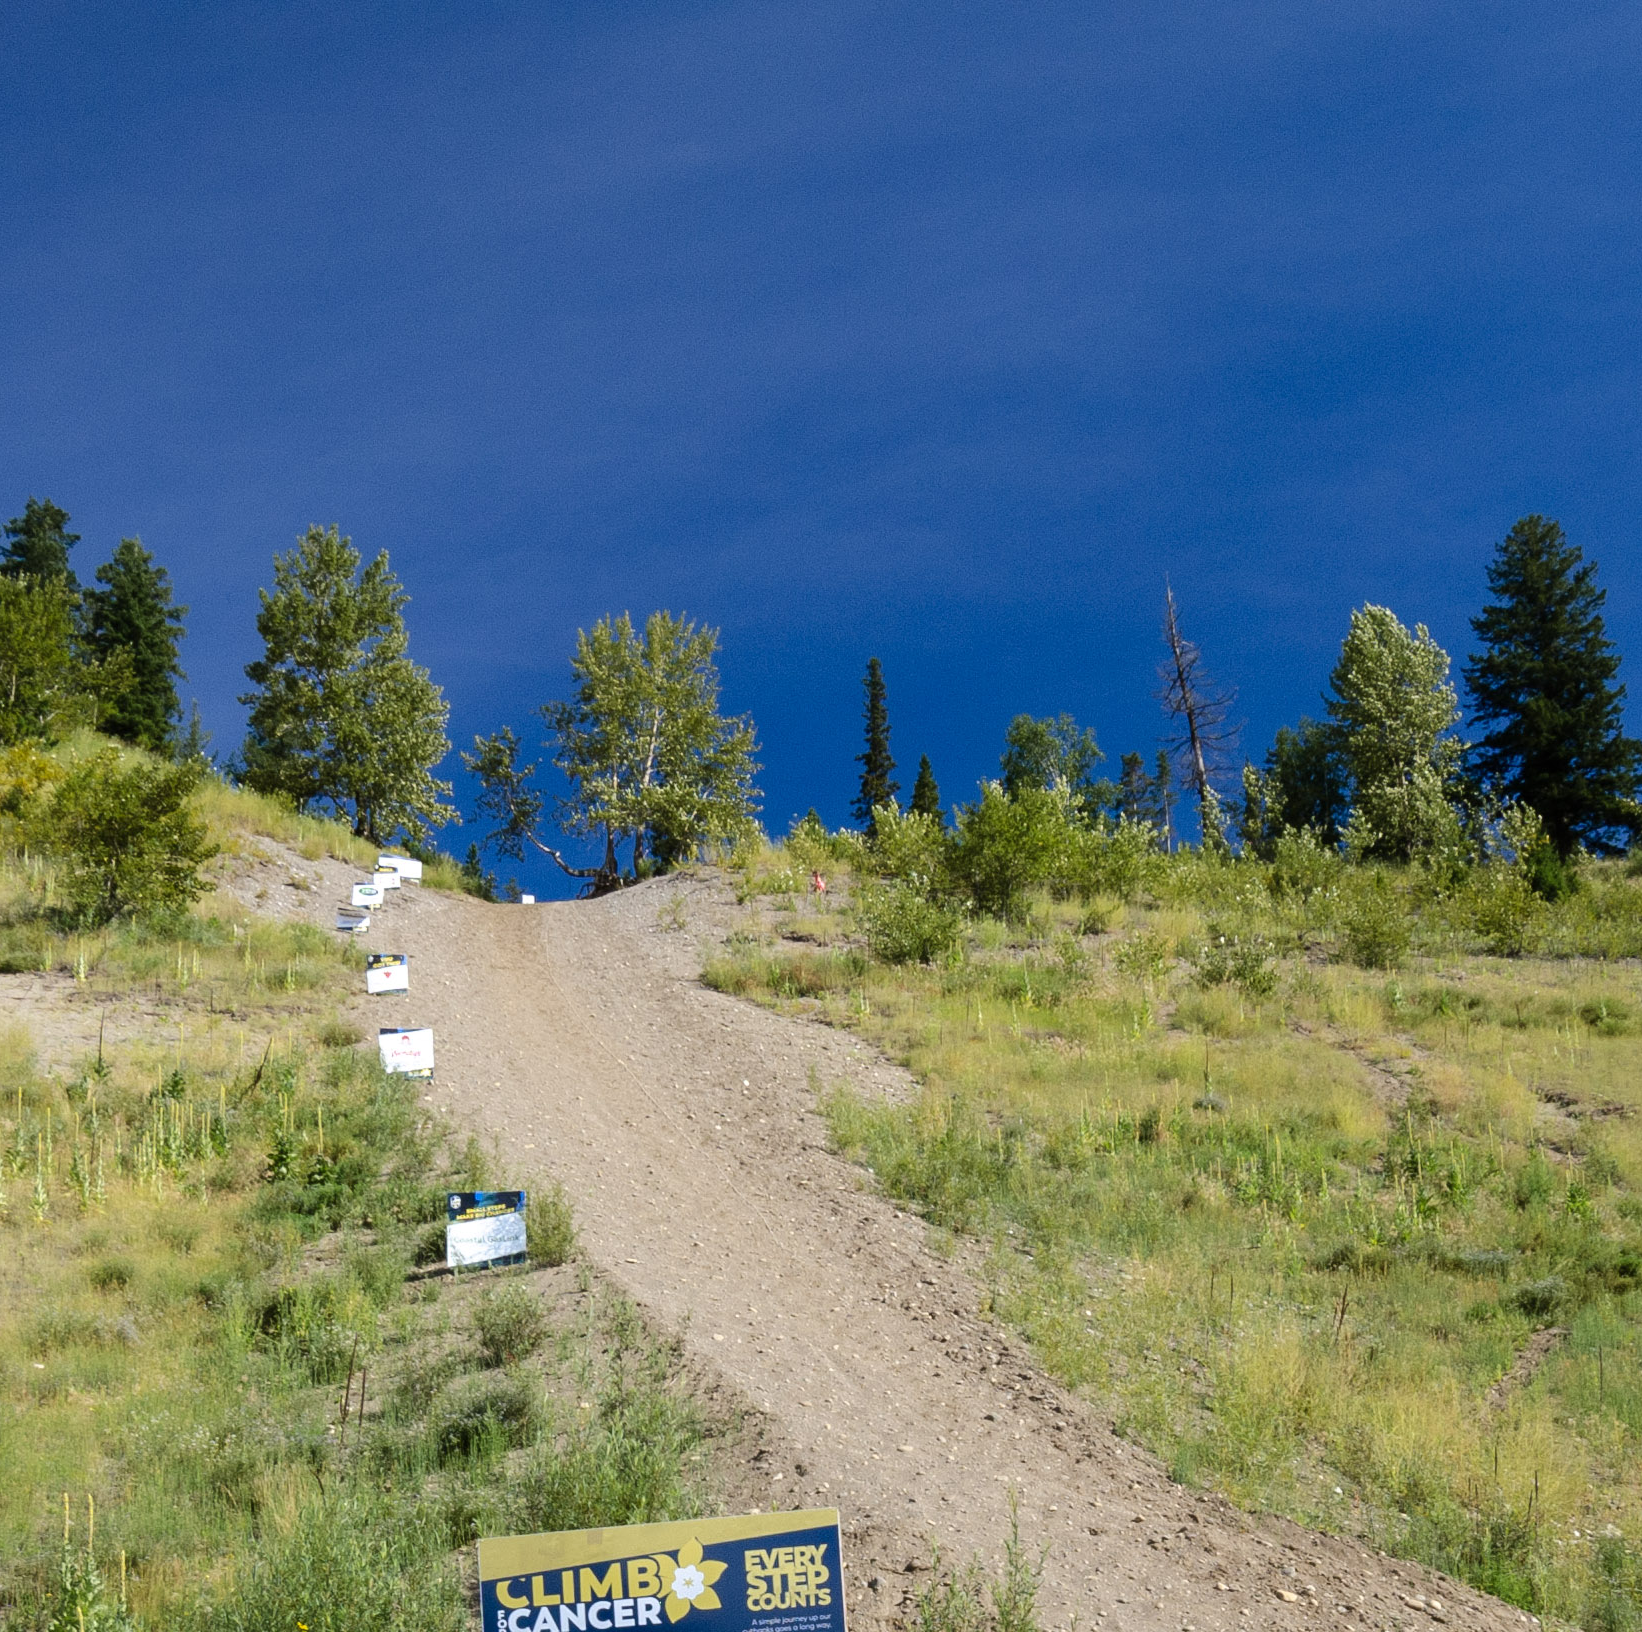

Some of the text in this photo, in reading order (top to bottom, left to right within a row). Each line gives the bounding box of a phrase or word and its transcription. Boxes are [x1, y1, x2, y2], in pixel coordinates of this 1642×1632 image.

[744, 1544, 828, 1572] EVERY
[496, 1558, 661, 1609] CLIMB
[746, 1564, 830, 1596] STEP
[747, 1588, 832, 1612] COUNTS
[759, 1617, 781, 1625] simple
[782, 1616, 807, 1624] journey
